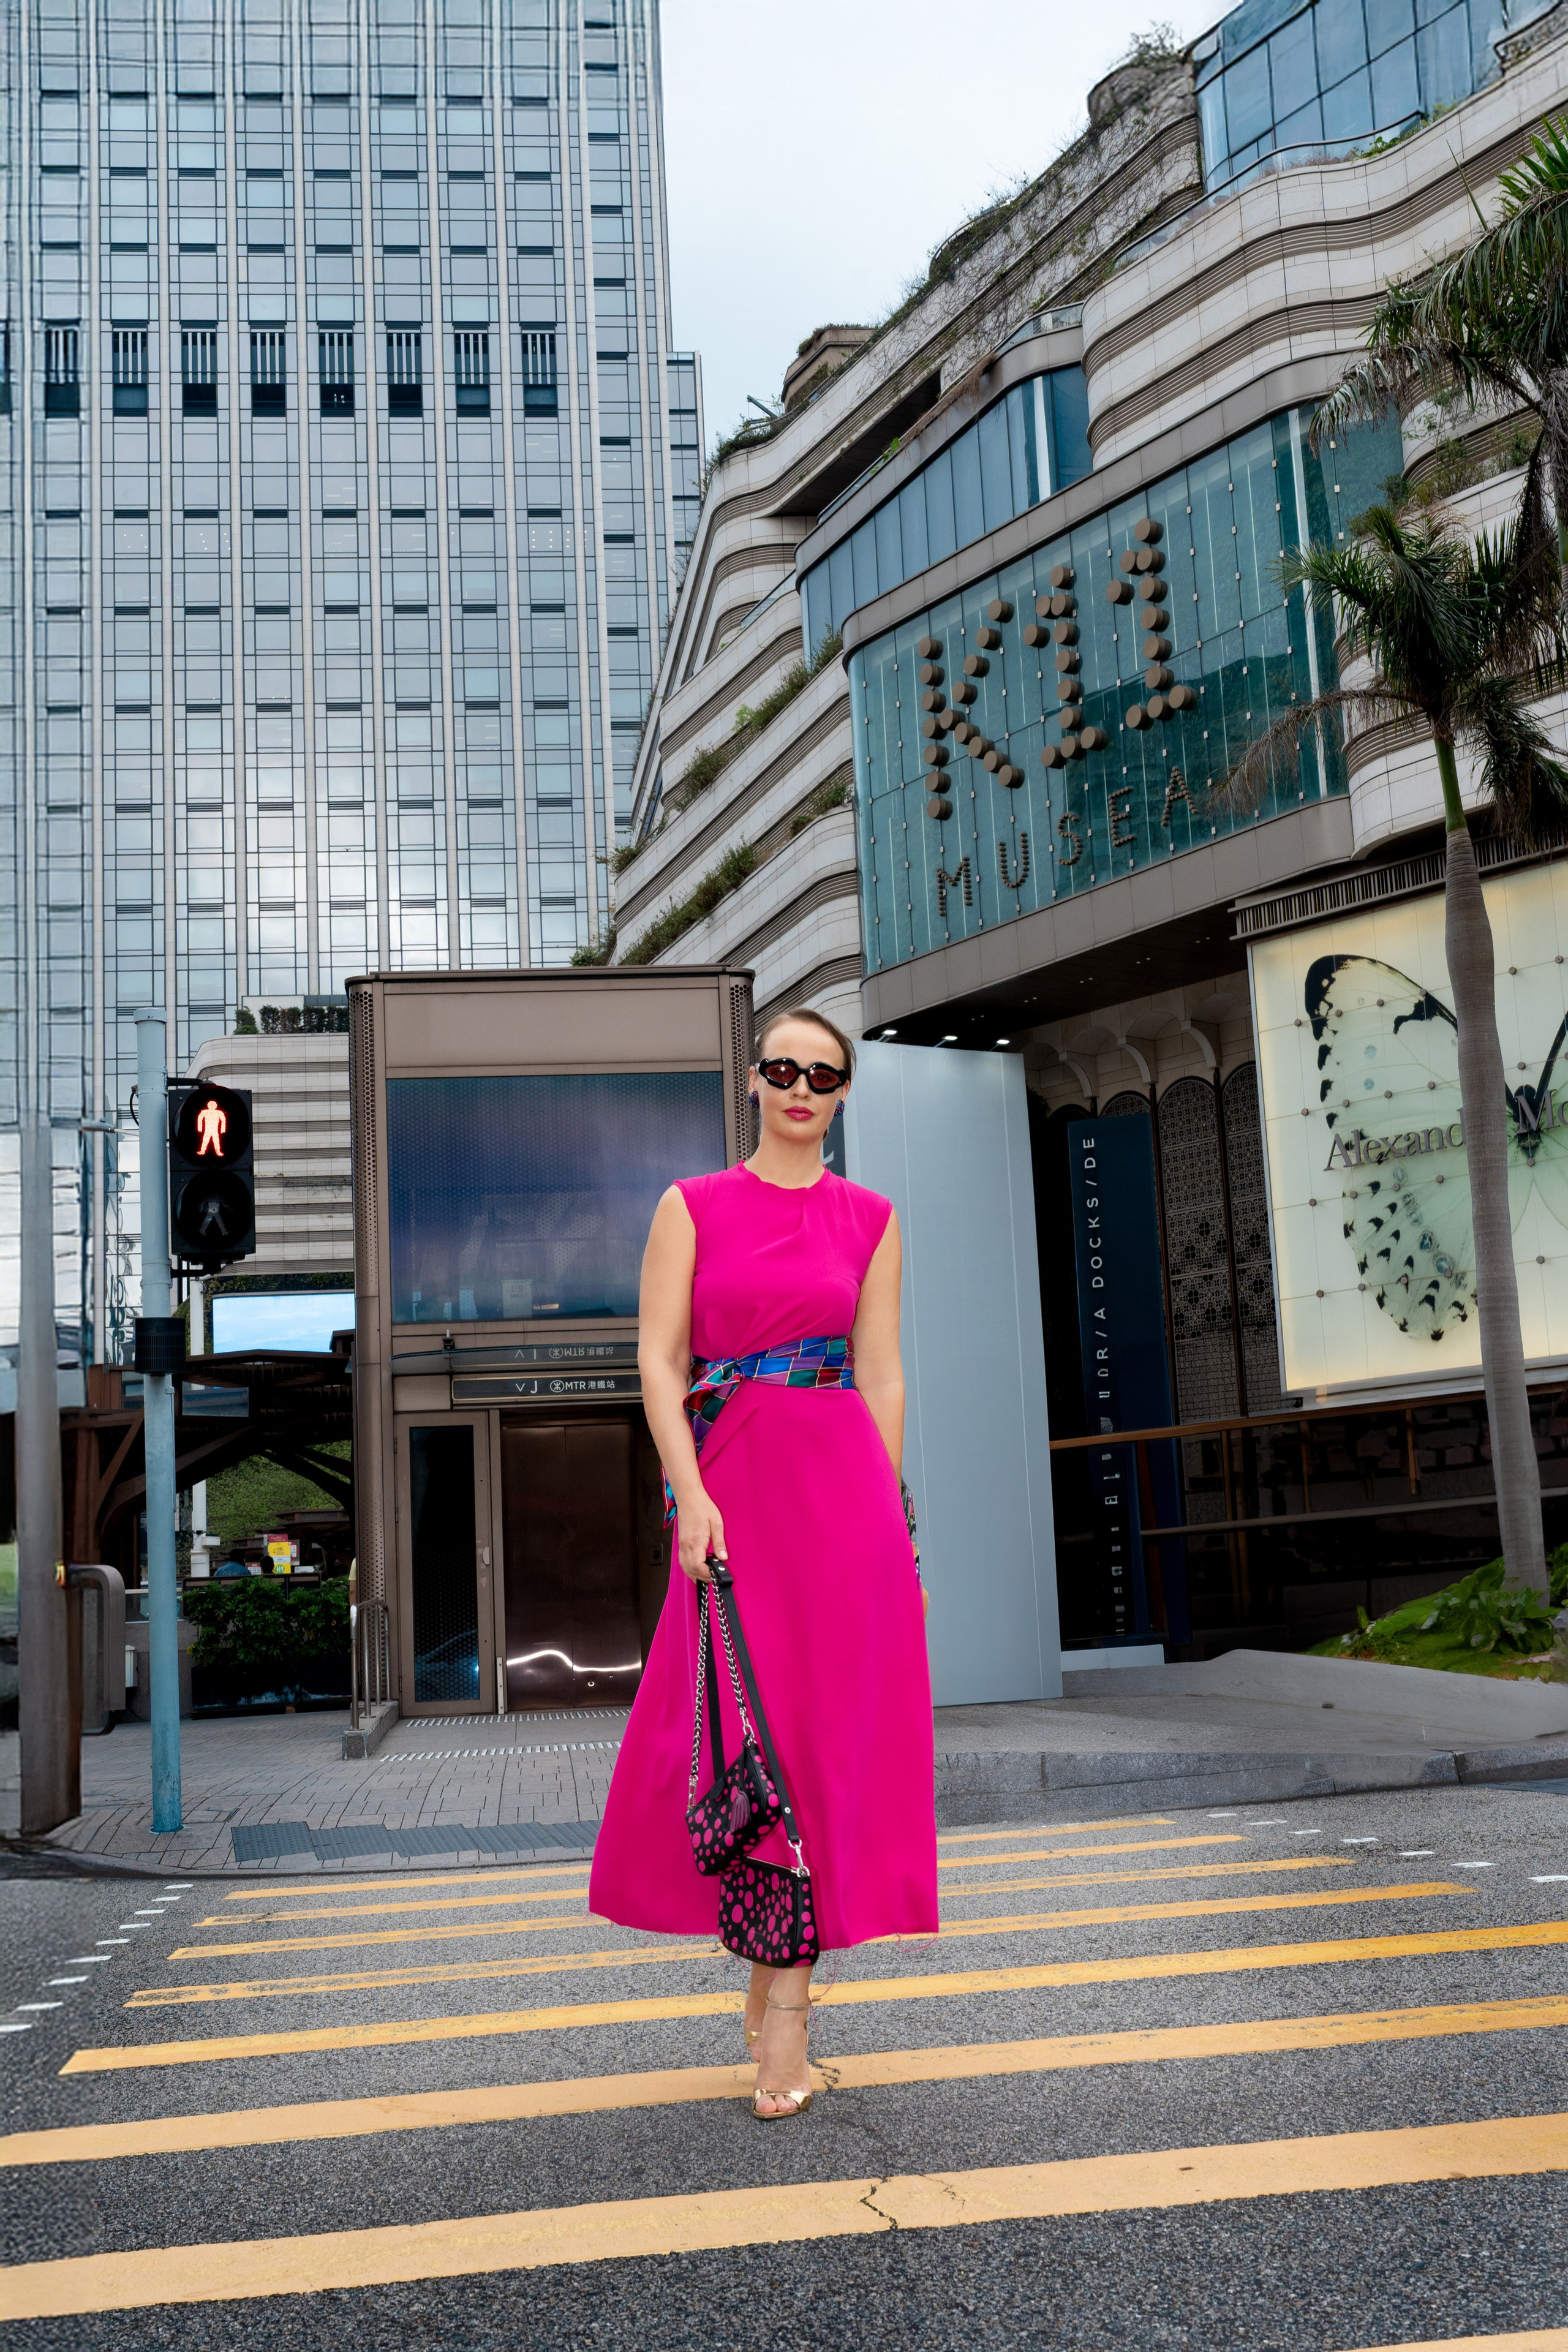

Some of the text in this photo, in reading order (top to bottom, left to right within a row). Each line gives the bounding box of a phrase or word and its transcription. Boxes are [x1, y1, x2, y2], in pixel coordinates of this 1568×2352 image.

[937, 766, 1198, 917] MUSEA
[1323, 1107, 1468, 1171] Alexand
[565, 1381, 586, 1390] MTR
[587, 1379, 615, 1389] 港鐵站
